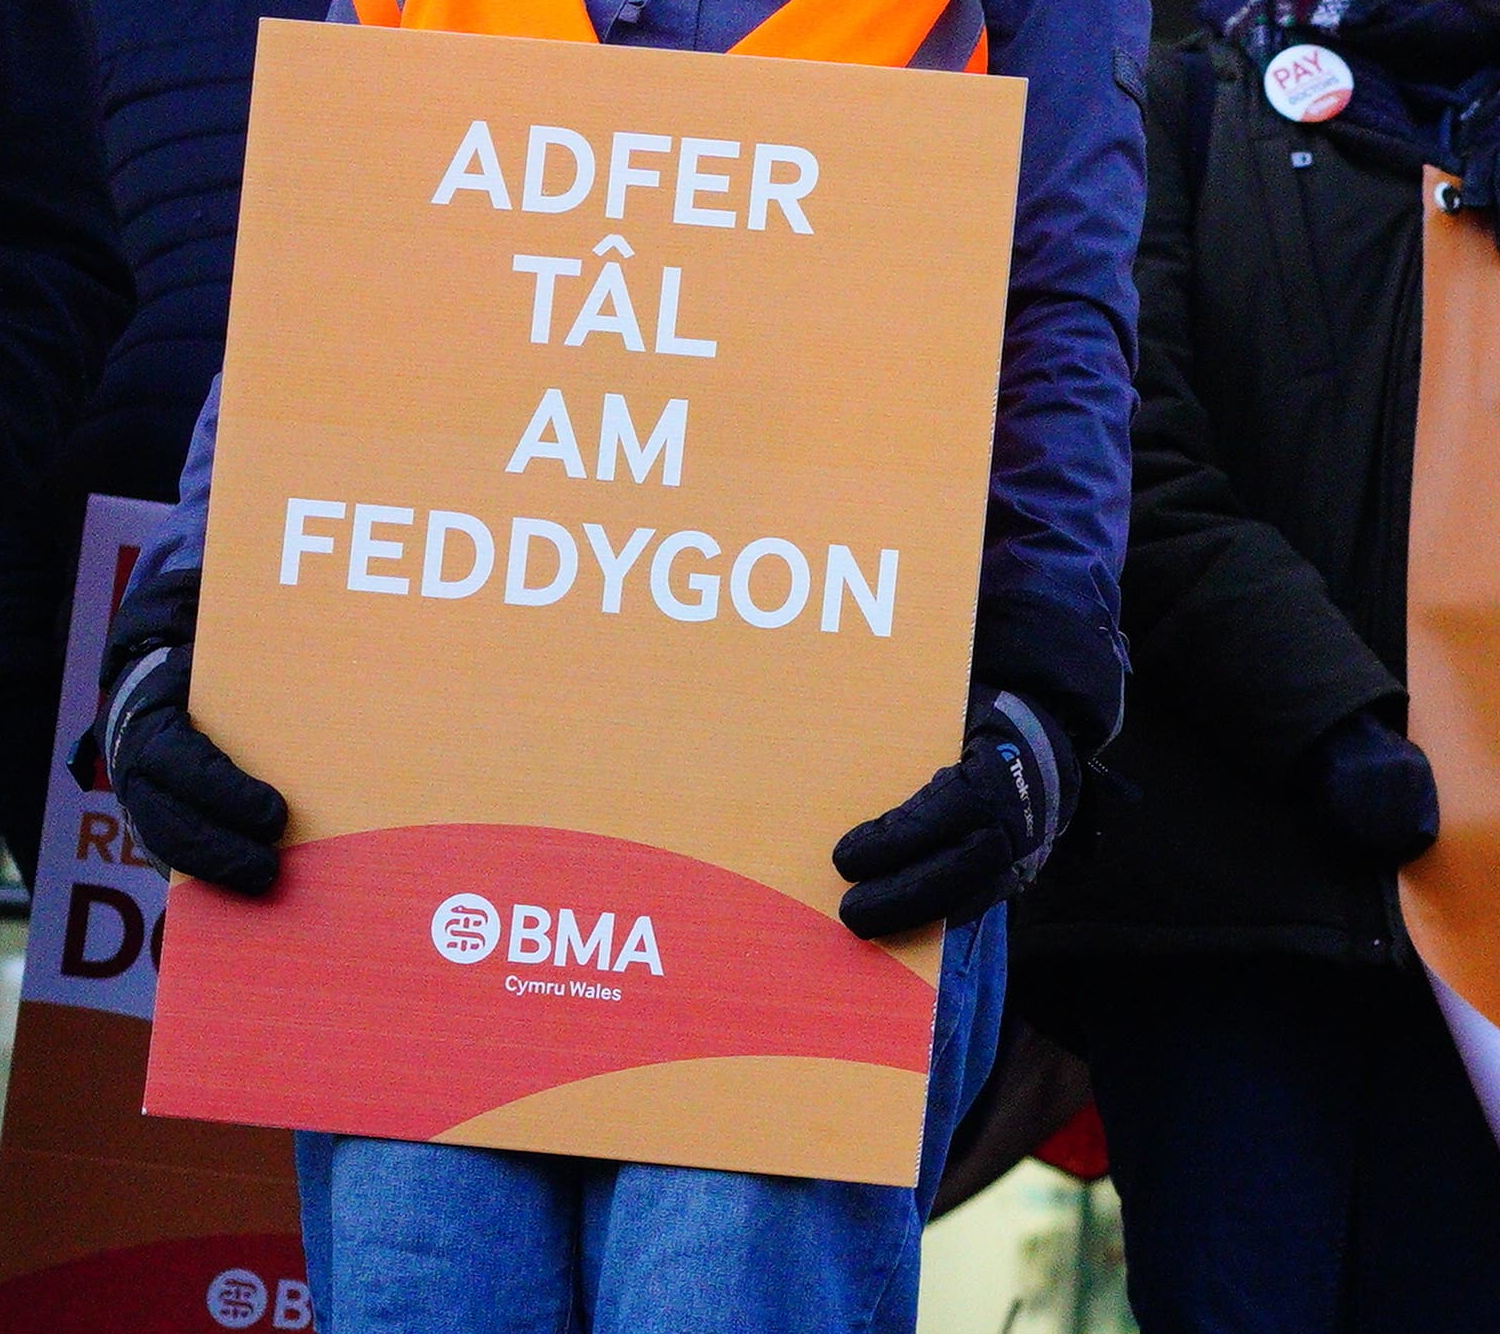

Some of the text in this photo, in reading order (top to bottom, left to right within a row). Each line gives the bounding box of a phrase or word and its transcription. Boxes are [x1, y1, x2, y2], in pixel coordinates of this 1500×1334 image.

[1272, 49, 1324, 90] PAY
[430, 119, 823, 236] ADFER
[510, 233, 718, 359] TÂL
[504, 387, 691, 488] AM
[279, 496, 899, 639] FEDDYGON
[505, 977, 623, 1003] Cymru Wales
[507, 904, 665, 978] BMA
